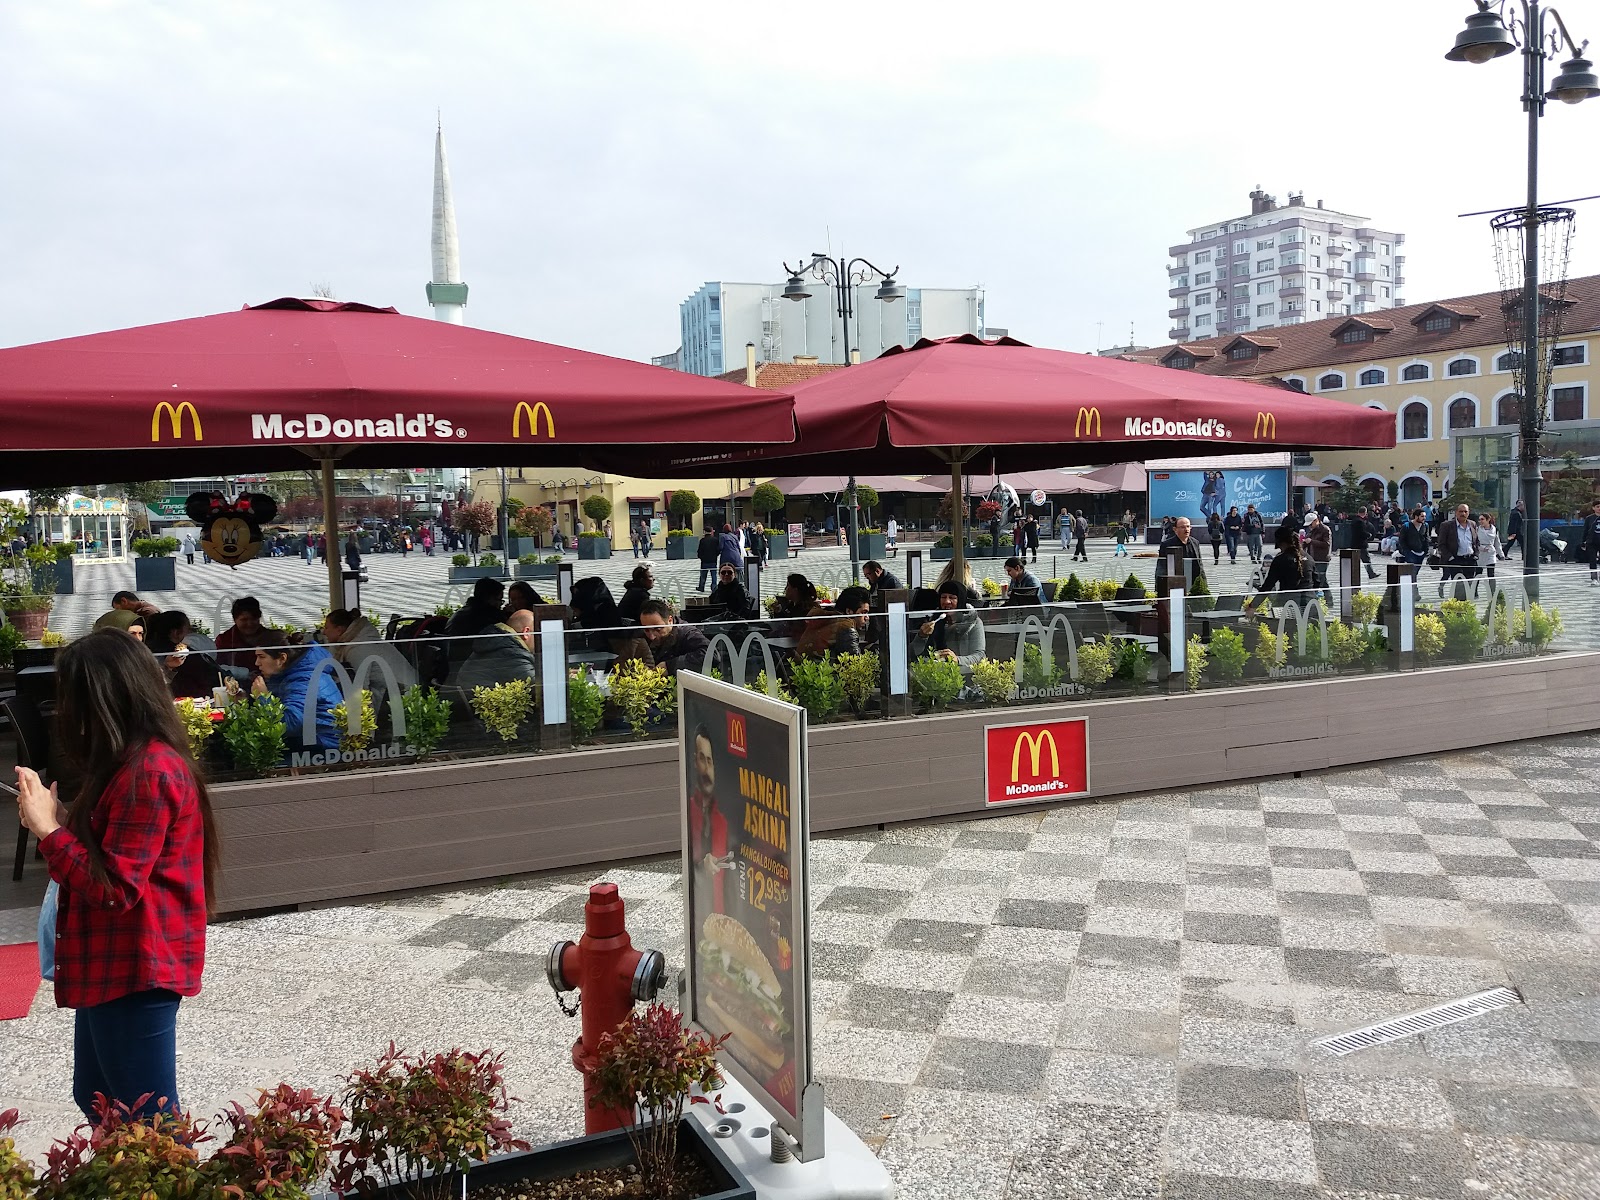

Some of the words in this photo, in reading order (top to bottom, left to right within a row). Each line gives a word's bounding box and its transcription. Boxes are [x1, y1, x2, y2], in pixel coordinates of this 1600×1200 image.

[1175, 490, 1187, 500] 29
[291, 743, 417, 768] McDonalds
[739, 766, 789, 817] MANGAL
[740, 843, 789, 881] MANGALBURGER
